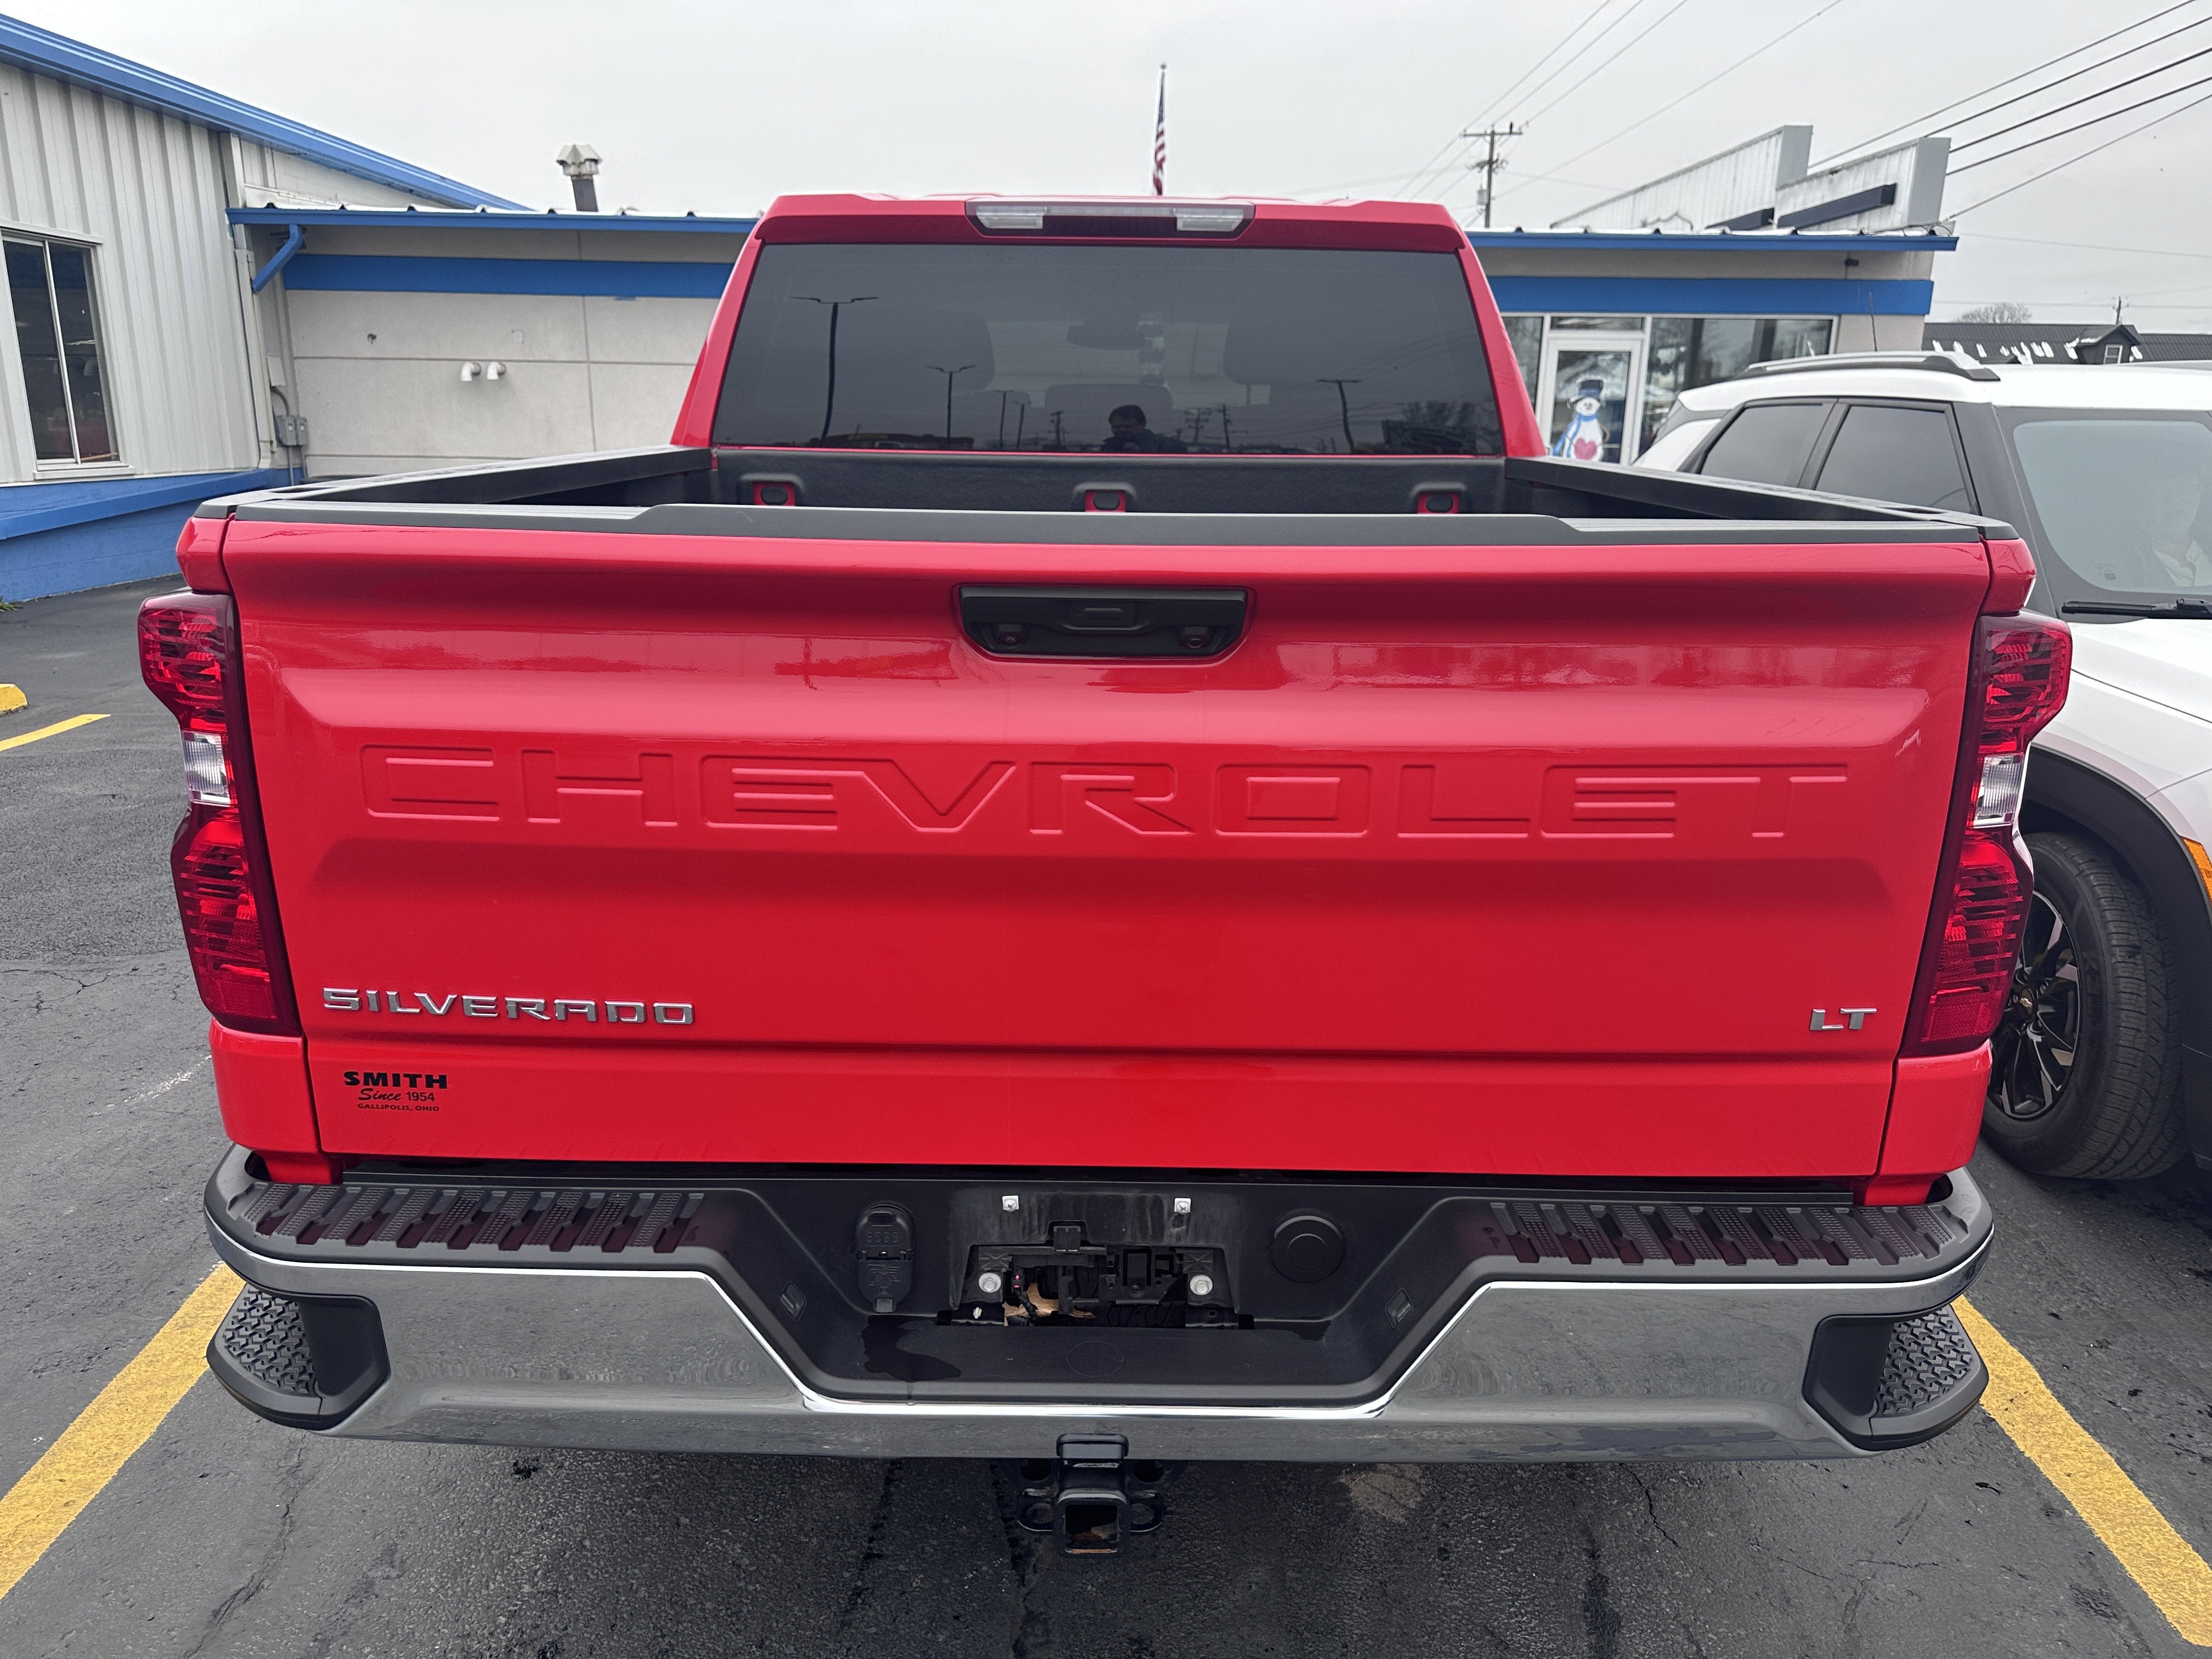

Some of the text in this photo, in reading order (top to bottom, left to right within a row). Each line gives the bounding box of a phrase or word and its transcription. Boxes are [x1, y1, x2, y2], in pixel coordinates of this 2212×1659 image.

[359, 744, 1849, 839] CHEVROLET
[322, 987, 695, 1025] SILVERADO
[1809, 1007, 1878, 1031] LT
[343, 1071, 448, 1089] SMITH
[358, 1088, 435, 1102] Since 1954
[358, 1103, 413, 1111] GALLIPOLIS,
